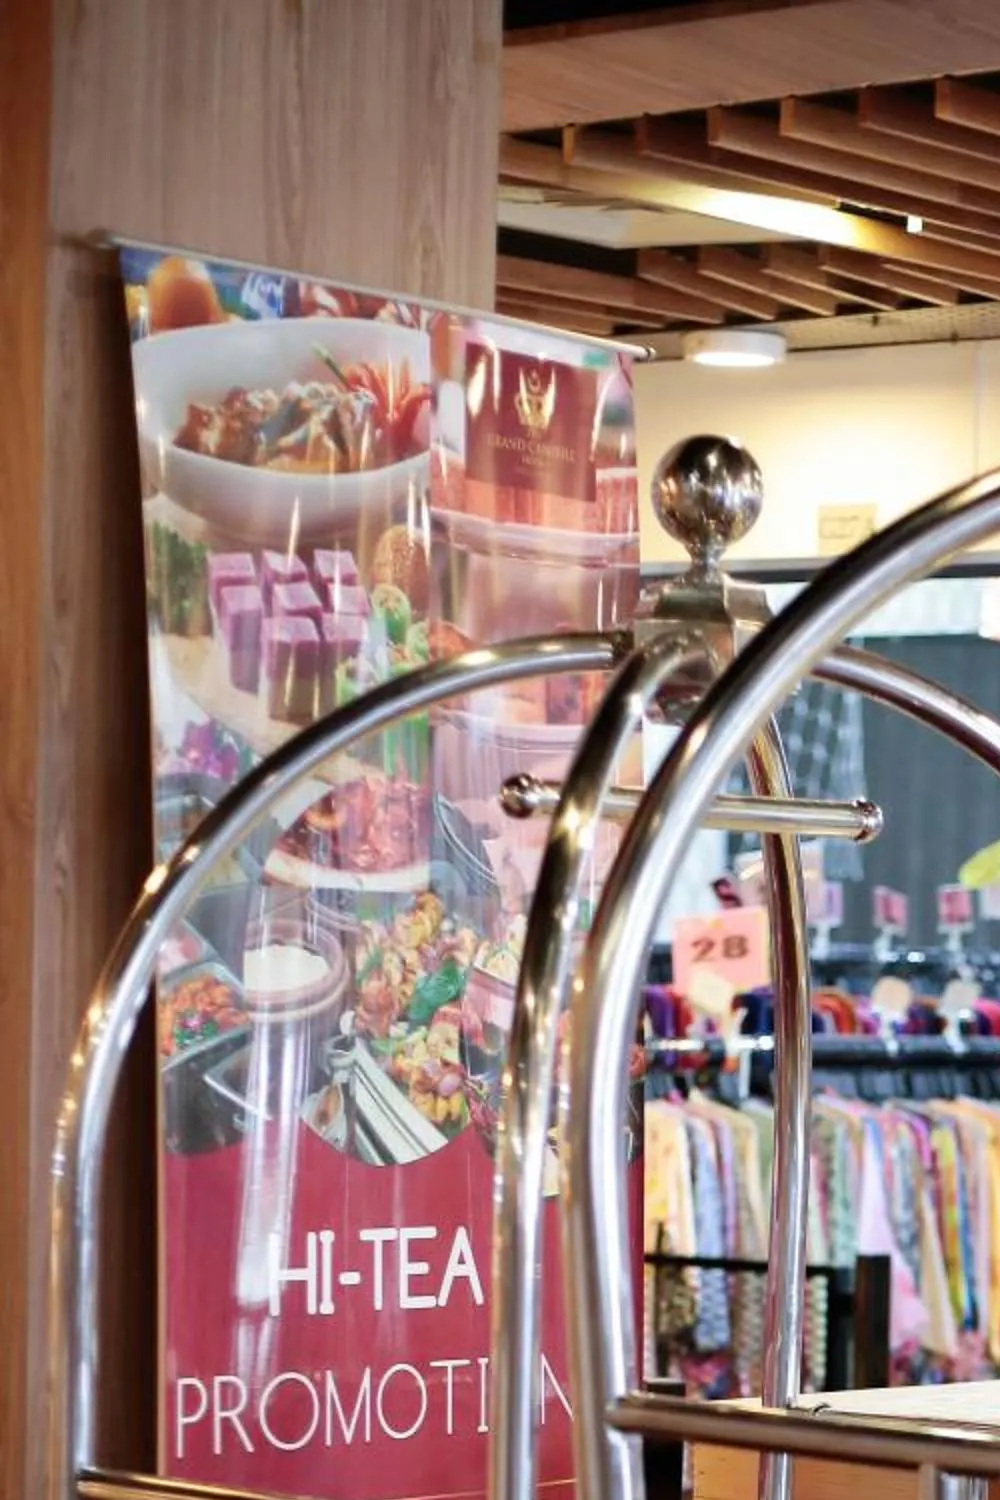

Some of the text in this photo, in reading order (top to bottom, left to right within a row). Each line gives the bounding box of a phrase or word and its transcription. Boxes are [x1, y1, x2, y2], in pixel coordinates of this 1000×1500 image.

[690, 935, 749, 962] 28
[268, 1225, 484, 1317] HI-TEA
[176, 1352, 575, 1459] PROMOTIN
